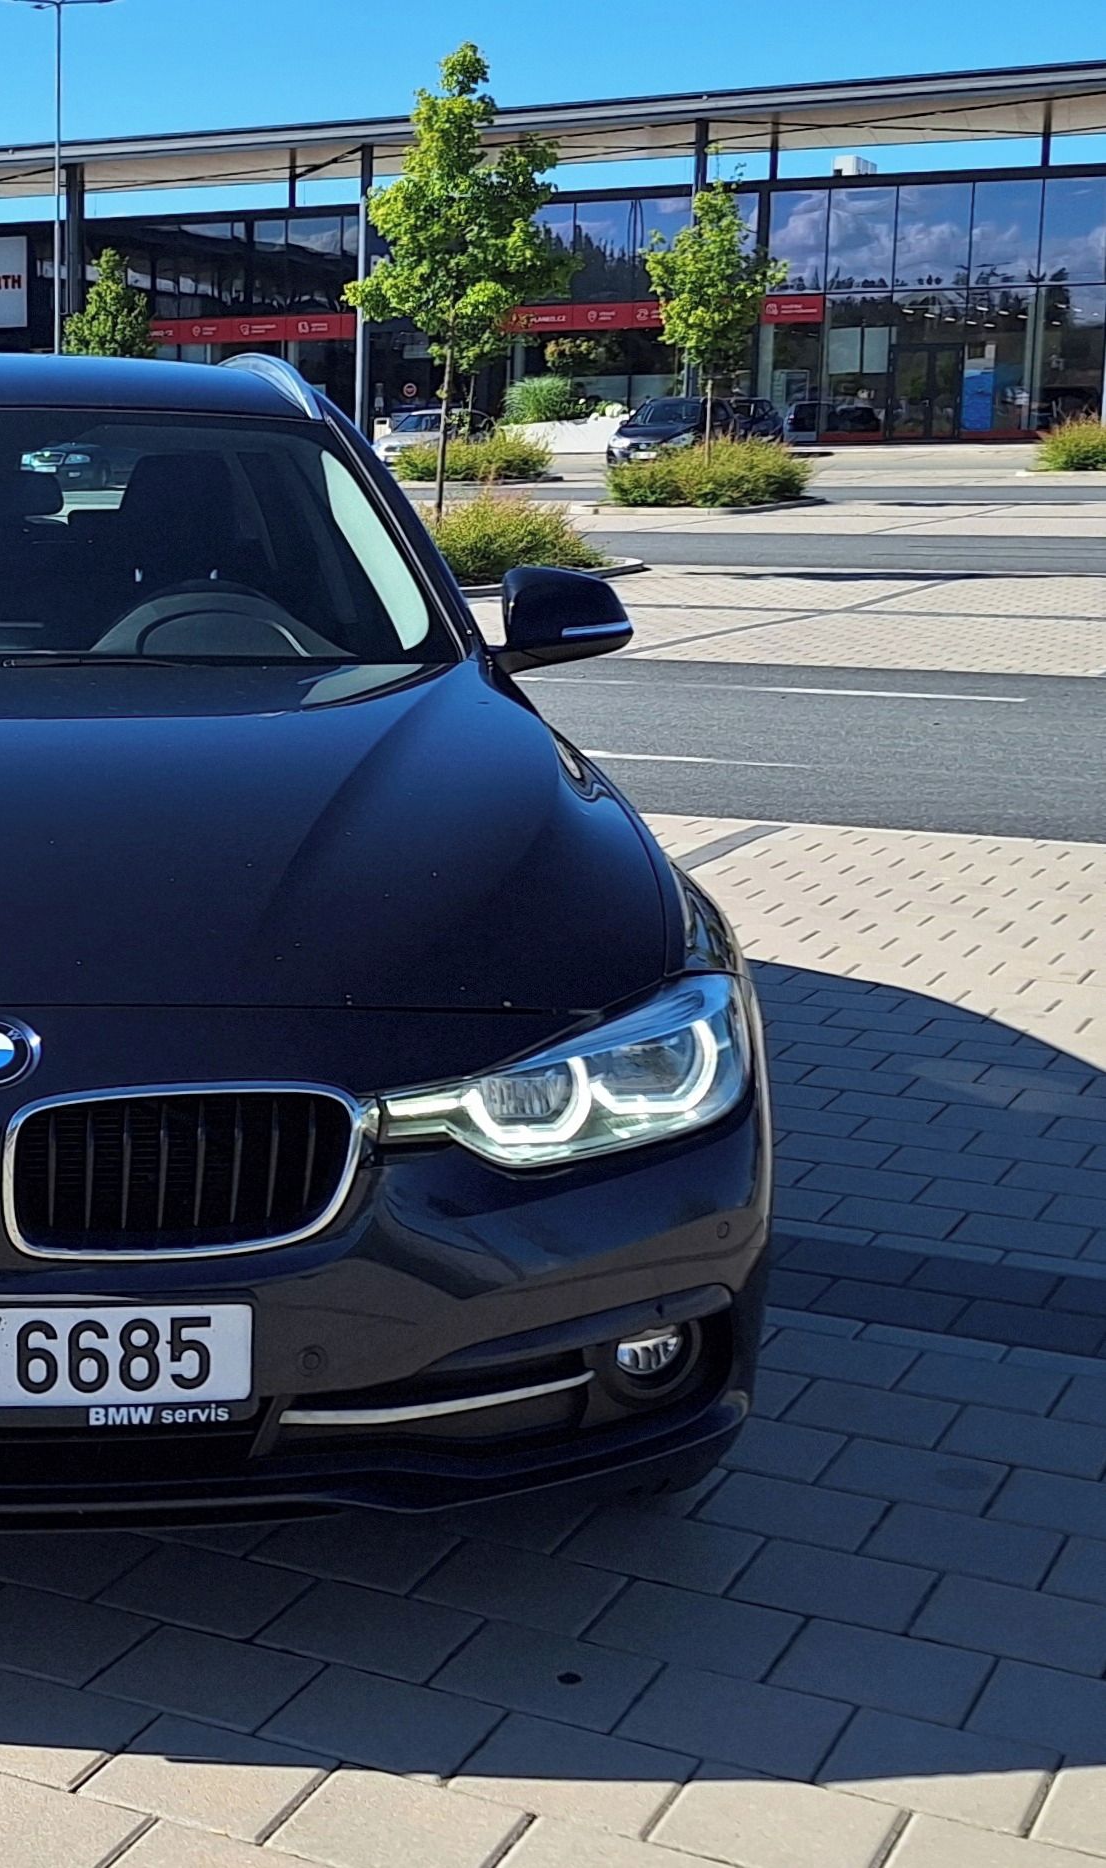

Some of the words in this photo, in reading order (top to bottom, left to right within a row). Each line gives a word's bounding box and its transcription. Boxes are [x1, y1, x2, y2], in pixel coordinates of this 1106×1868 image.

[16, 1316, 212, 1394] 6685
[88, 1406, 155, 1426] BMW
[160, 1403, 230, 1424] servis
